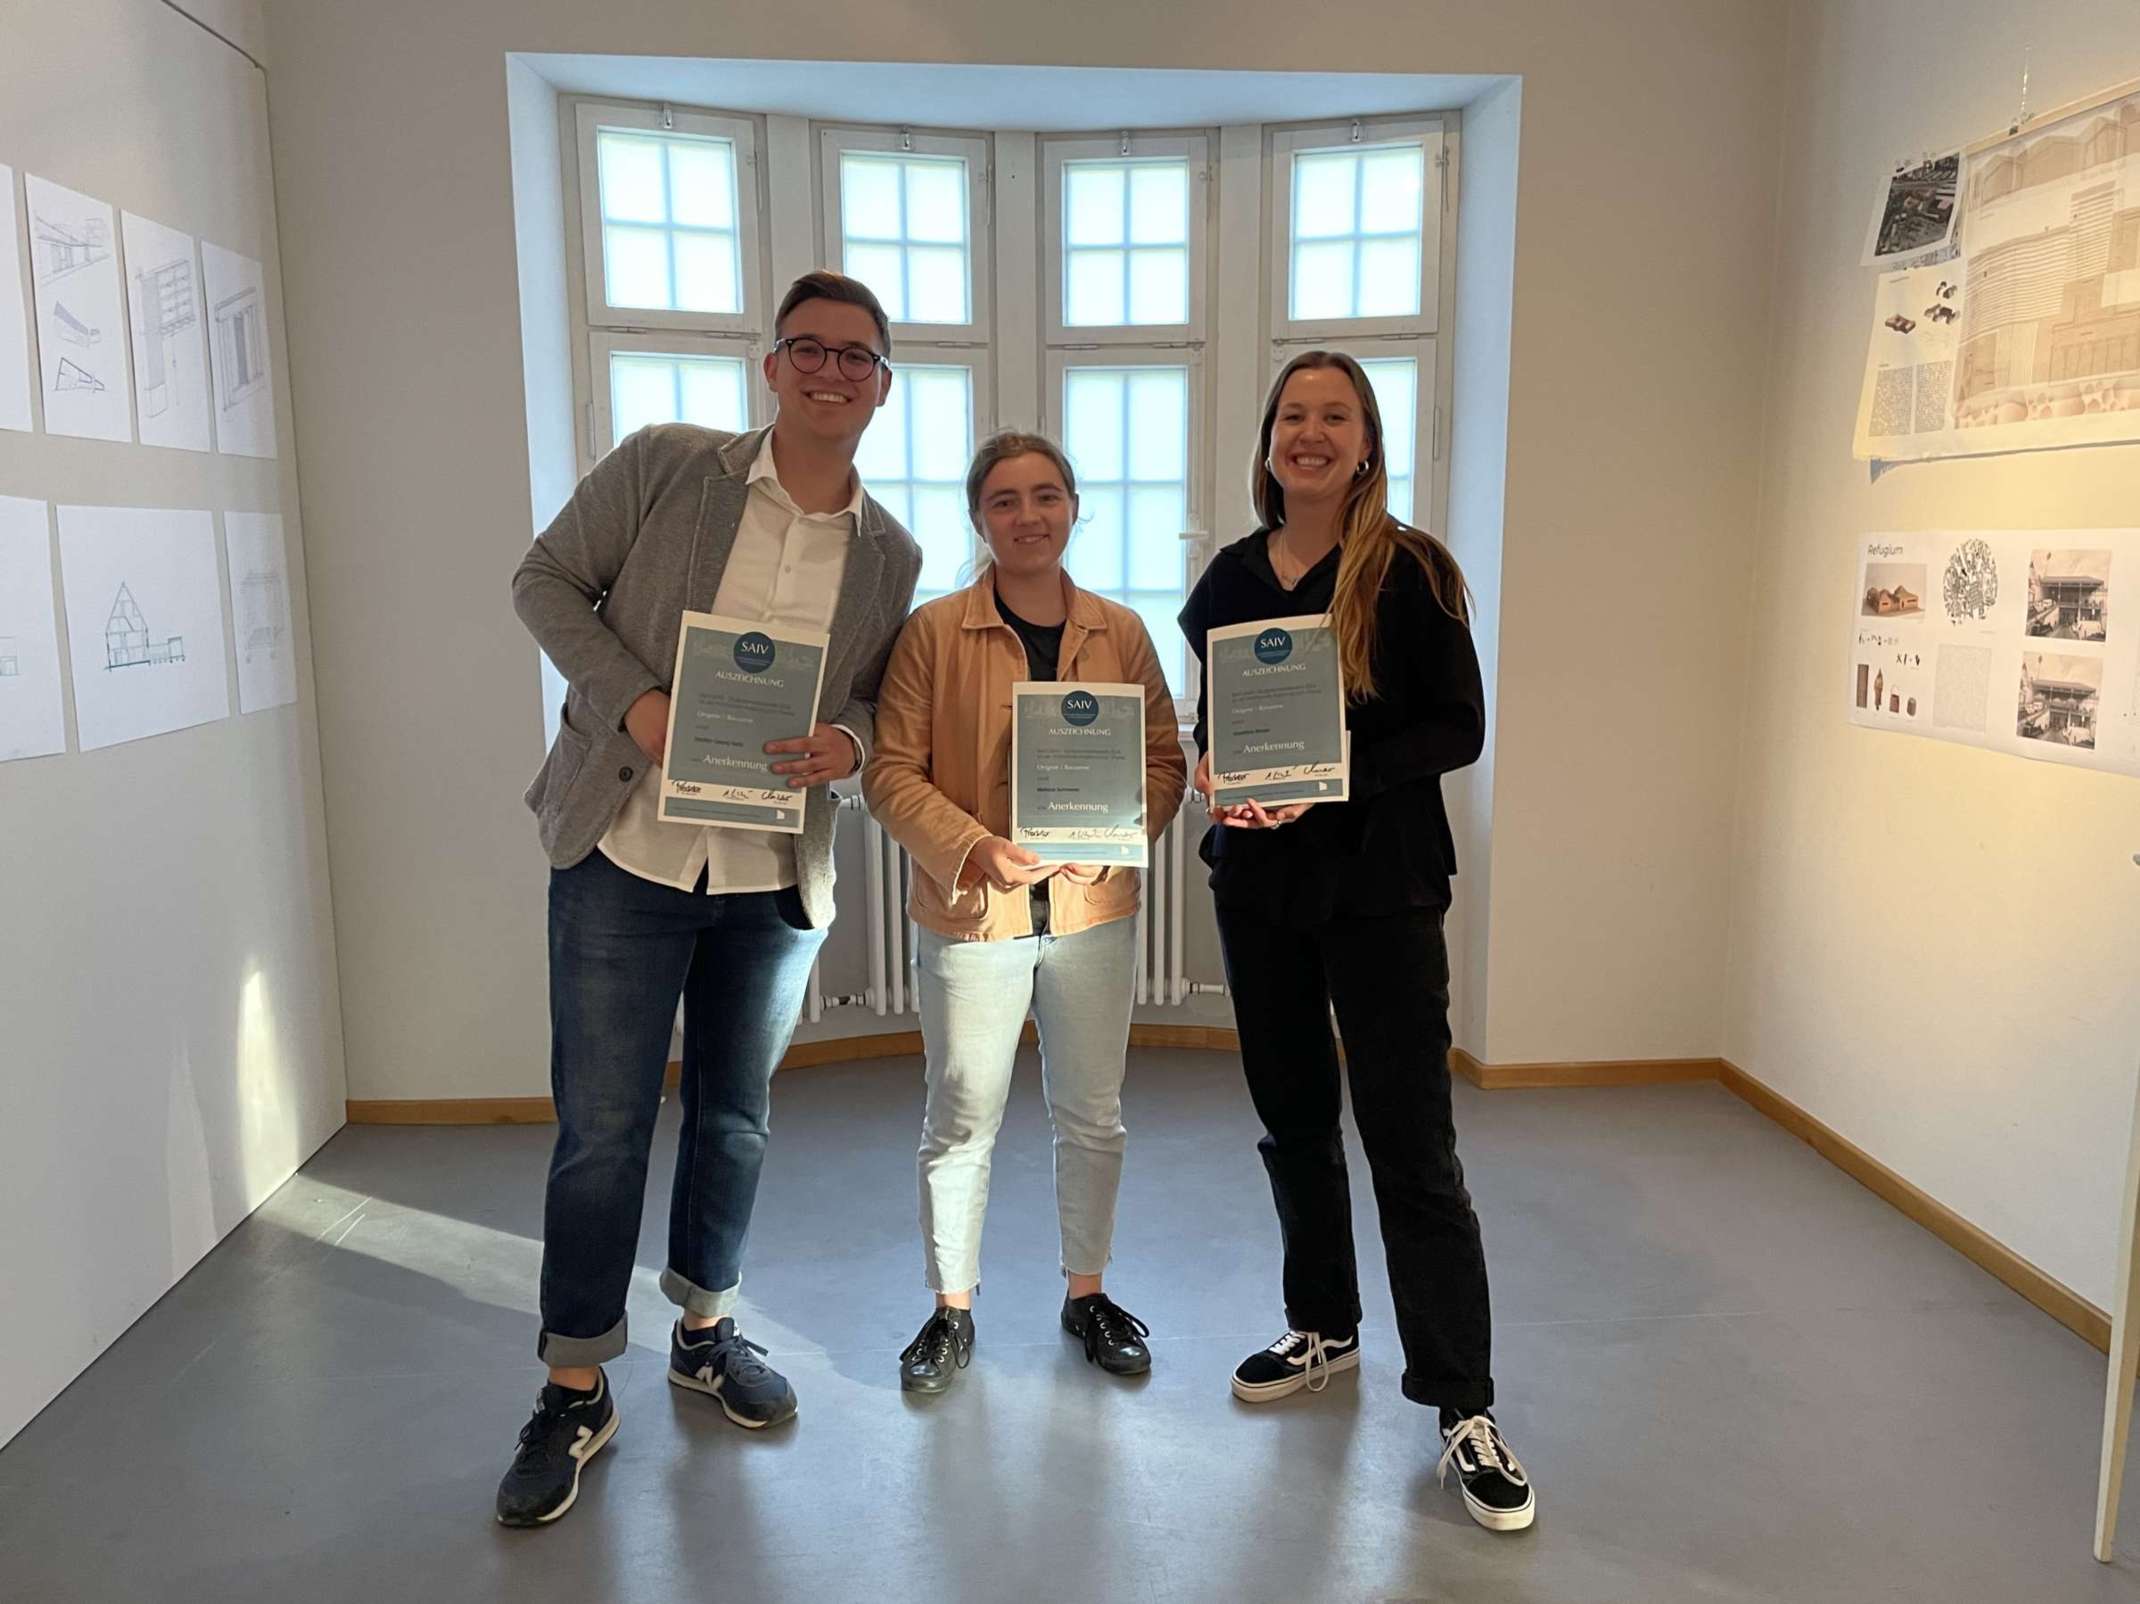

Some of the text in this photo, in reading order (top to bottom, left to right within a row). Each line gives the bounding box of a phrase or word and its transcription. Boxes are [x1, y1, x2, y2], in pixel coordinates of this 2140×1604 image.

[1867, 543, 1904, 557] Refugium
[741, 641, 769, 655] SAIV
[1260, 636, 1286, 648] SAIV
[1242, 662, 1307, 677] AUSZEICHNUNG
[715, 670, 784, 688] AUSZEICHNUNG
[1067, 700, 1092, 710] SAIV
[1243, 740, 1305, 753] Anerkennung
[703, 754, 768, 773] Anerkennung
[1048, 801, 1109, 813] Anerkennung
